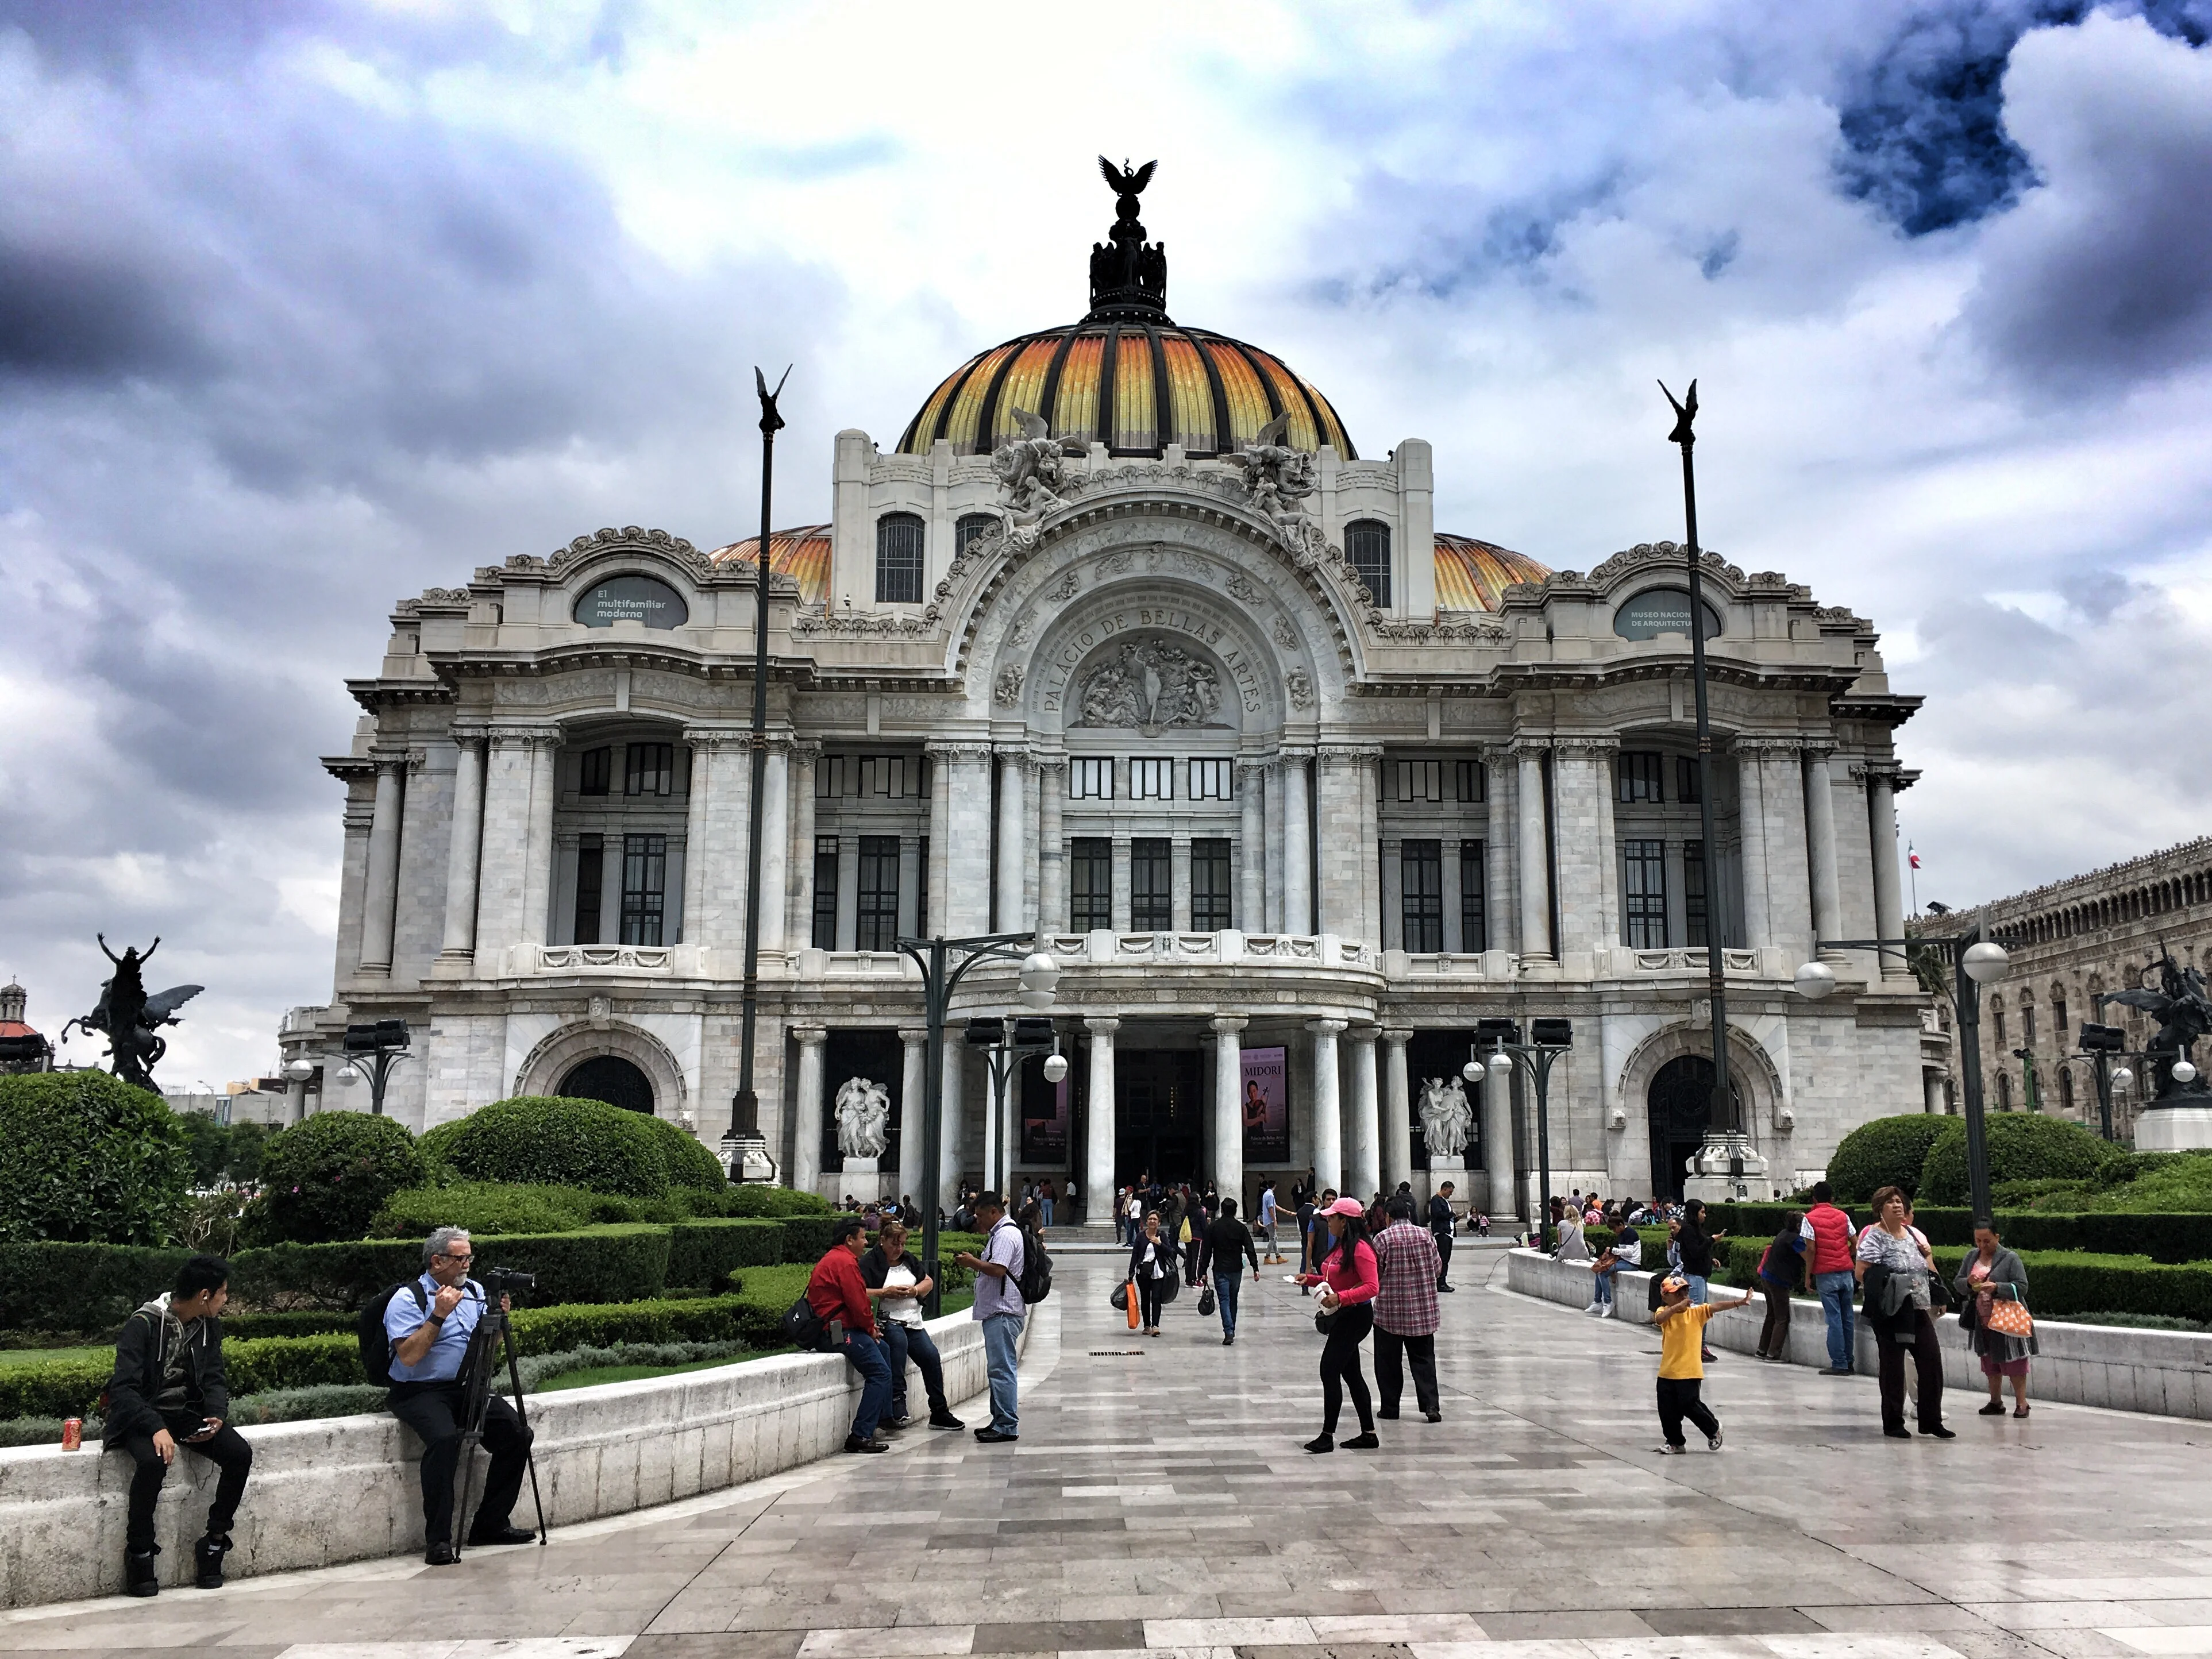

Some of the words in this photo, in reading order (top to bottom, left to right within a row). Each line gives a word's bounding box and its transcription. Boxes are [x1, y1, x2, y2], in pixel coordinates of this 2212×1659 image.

[598, 590, 607, 598] El
[598, 600, 666, 608] multifamiliar
[597, 609, 643, 618] moderno
[1045, 633, 1093, 712] PALACIO
[1101, 614, 1128, 635] DE
[1140, 609, 1219, 645] BELLAS
[1223, 651, 1261, 712] ARTES
[1244, 1066, 1282, 1076] MIDORI
